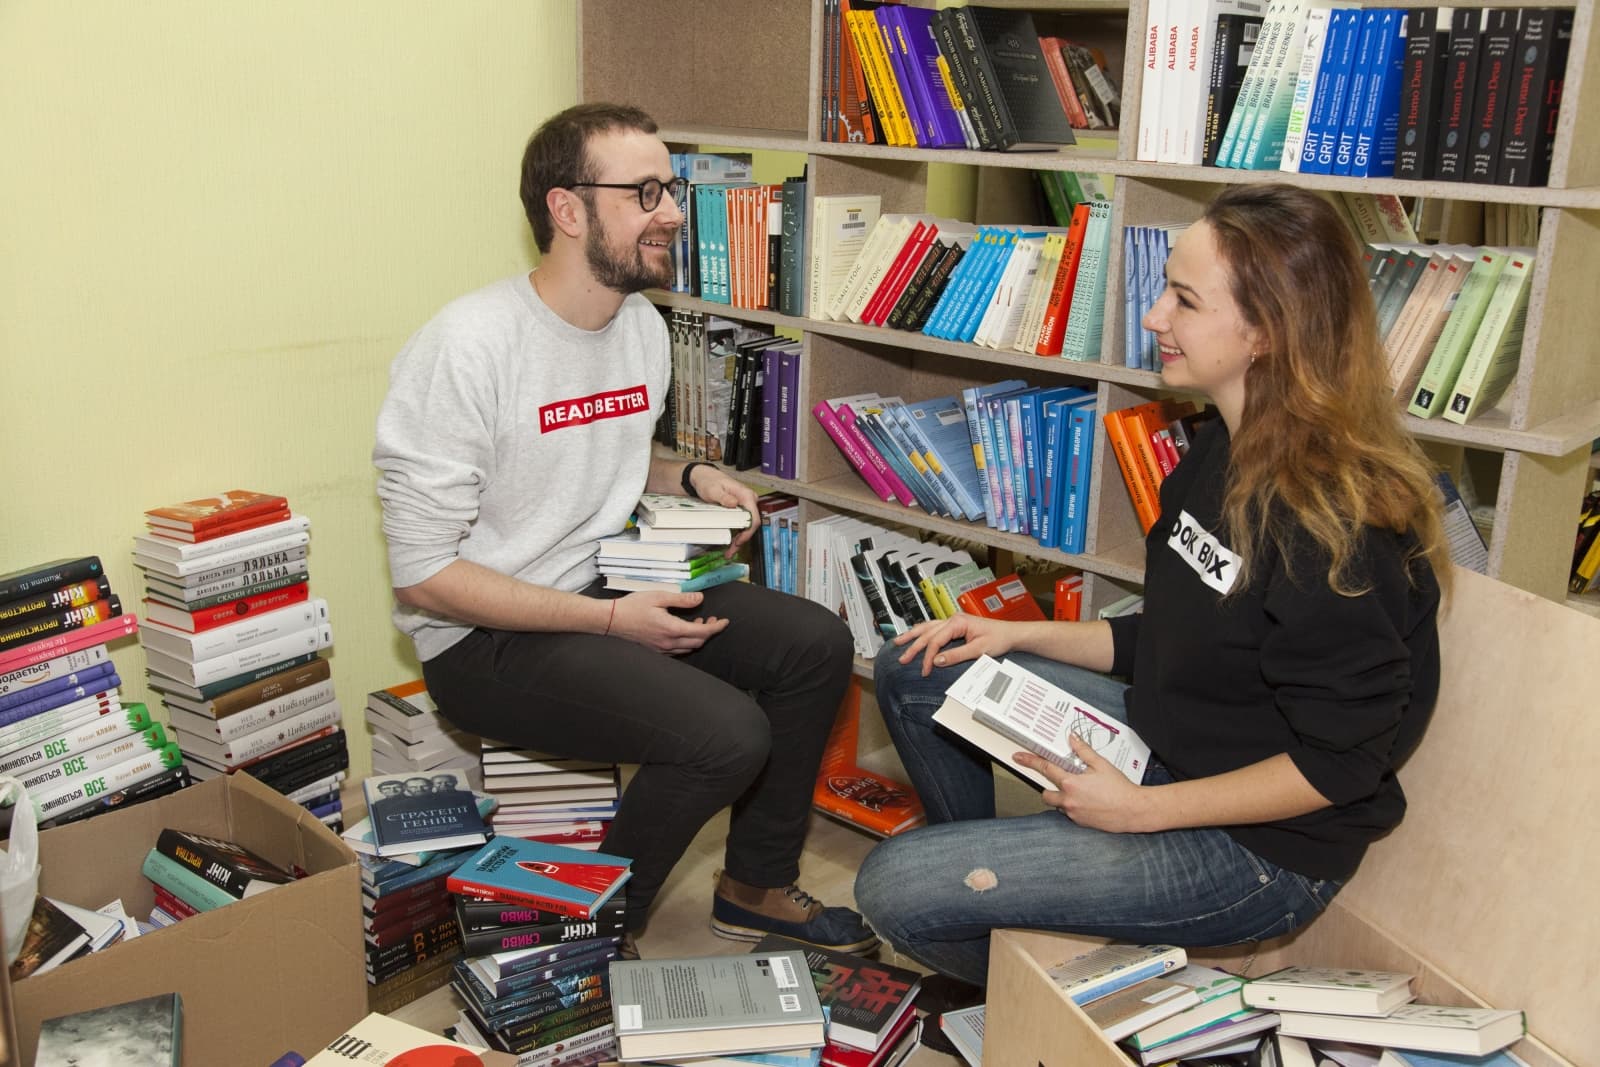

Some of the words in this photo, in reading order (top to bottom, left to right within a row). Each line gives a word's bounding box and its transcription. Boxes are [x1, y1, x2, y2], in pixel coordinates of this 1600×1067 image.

[1148, 25, 1158, 70] ALIBABA
[1168, 25, 1178, 70] ALIBABA
[1188, 26, 1199, 71] ALIBABA
[1238, 77, 1253, 107] BRAVING
[1252, 22, 1272, 67] WILDERNESS
[1249, 77, 1264, 108] BRAVING
[1263, 22, 1282, 68] WILDERNESS
[1262, 77, 1278, 108] BRAVING
[1276, 22, 1295, 68] WILDERNESS
[1411, 60, 1423, 86] Deus
[1453, 62, 1467, 90] Deus
[1488, 62, 1501, 89] Deus
[1295, 79, 1312, 105] TAKE
[1519, 67, 1534, 102] Homo
[1289, 110, 1306, 133] GIVE
[1408, 90, 1420, 126] Homo
[1449, 93, 1461, 128] Homo
[1483, 93, 1496, 128] Homo
[1514, 107, 1528, 136] Deus
[1211, 113, 1219, 140] TYSON
[1303, 130, 1319, 162] GRIT
[1319, 132, 1335, 164] GRIT
[1337, 132, 1352, 165] GRIT
[1354, 133, 1371, 166] GRIT
[701, 255, 709, 293] mindset
[710, 256, 718, 294] mindset
[837, 285, 850, 304] DAILY
[849, 263, 862, 284] STOIC
[856, 286, 869, 306] DAILY
[869, 266, 882, 286] STOIC
[930, 298, 945, 317] POWER
[967, 302, 982, 323] POWER
[1042, 315, 1055, 345] MANSON
[242, 552, 289, 573] ЛЯЛЬКА
[242, 565, 289, 587] ЛЯЛЬКА
[1197, 542, 1230, 581] BIX
[52, 585, 85, 606] КІНГ
[64, 604, 96, 627] КІНГ
[43, 738, 70, 760] ВСЕ
[62, 755, 88, 777] ВСЕ
[40, 789, 83, 813] ЗМІНЮЄТЬСЯ
[84, 777, 108, 798] ВСЕ
[206, 862, 232, 885] КІНГ
[500, 909, 539, 923] СЯЙВО
[560, 922, 597, 938] КІНГ
[502, 932, 540, 949] СЯЙВО
